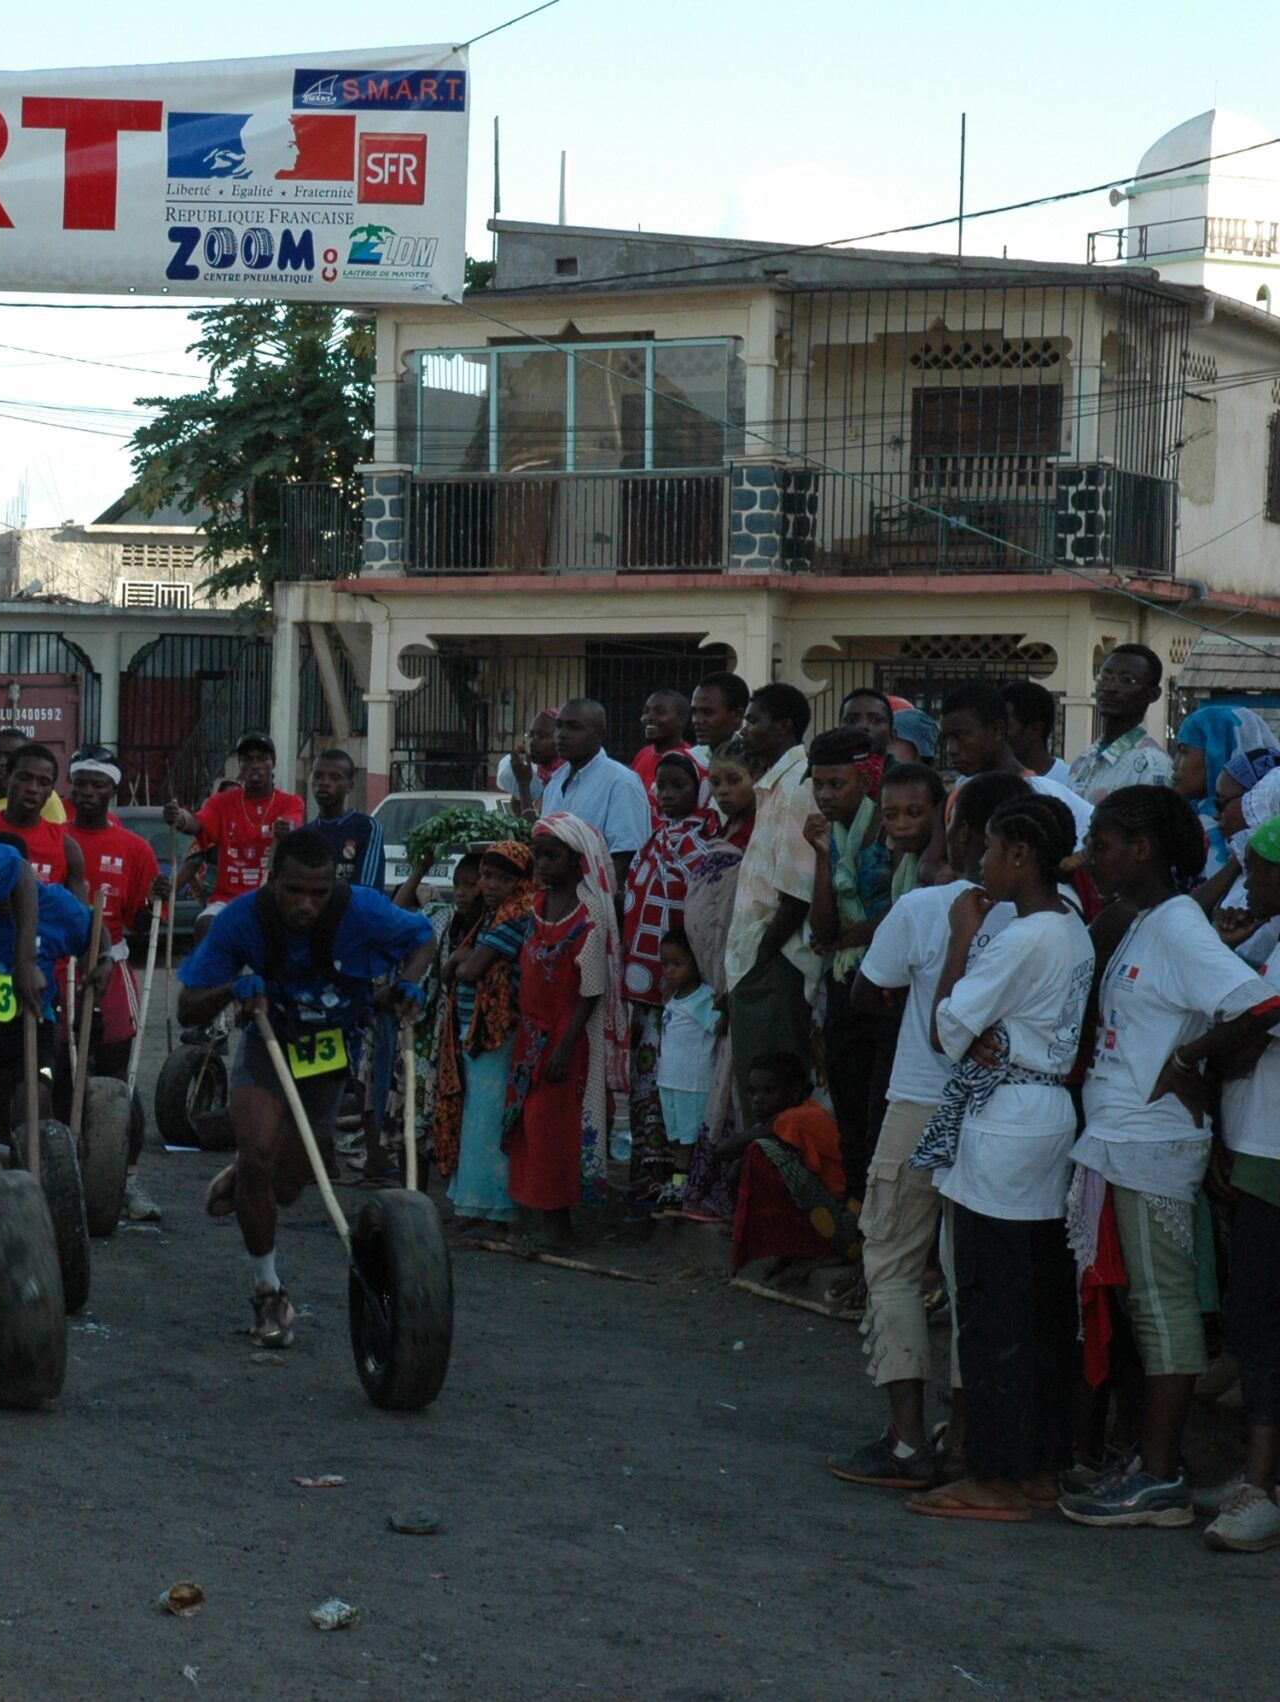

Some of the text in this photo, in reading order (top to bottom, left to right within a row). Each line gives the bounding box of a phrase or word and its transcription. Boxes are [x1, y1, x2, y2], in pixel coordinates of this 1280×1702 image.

[365, 152, 418, 186] SFR
[166, 183, 355, 199] Liberté Egalité Fraternité
[165, 206, 265, 225] REPUBLIQUE
[165, 226, 316, 281] ZOOM
[380, 236, 439, 268] LDM
[203, 272, 314, 285] CENTRE PNEUMATIQUE
[342, 270, 377, 278] LAITERIE
[392, 270, 430, 279] MAYOTTE
